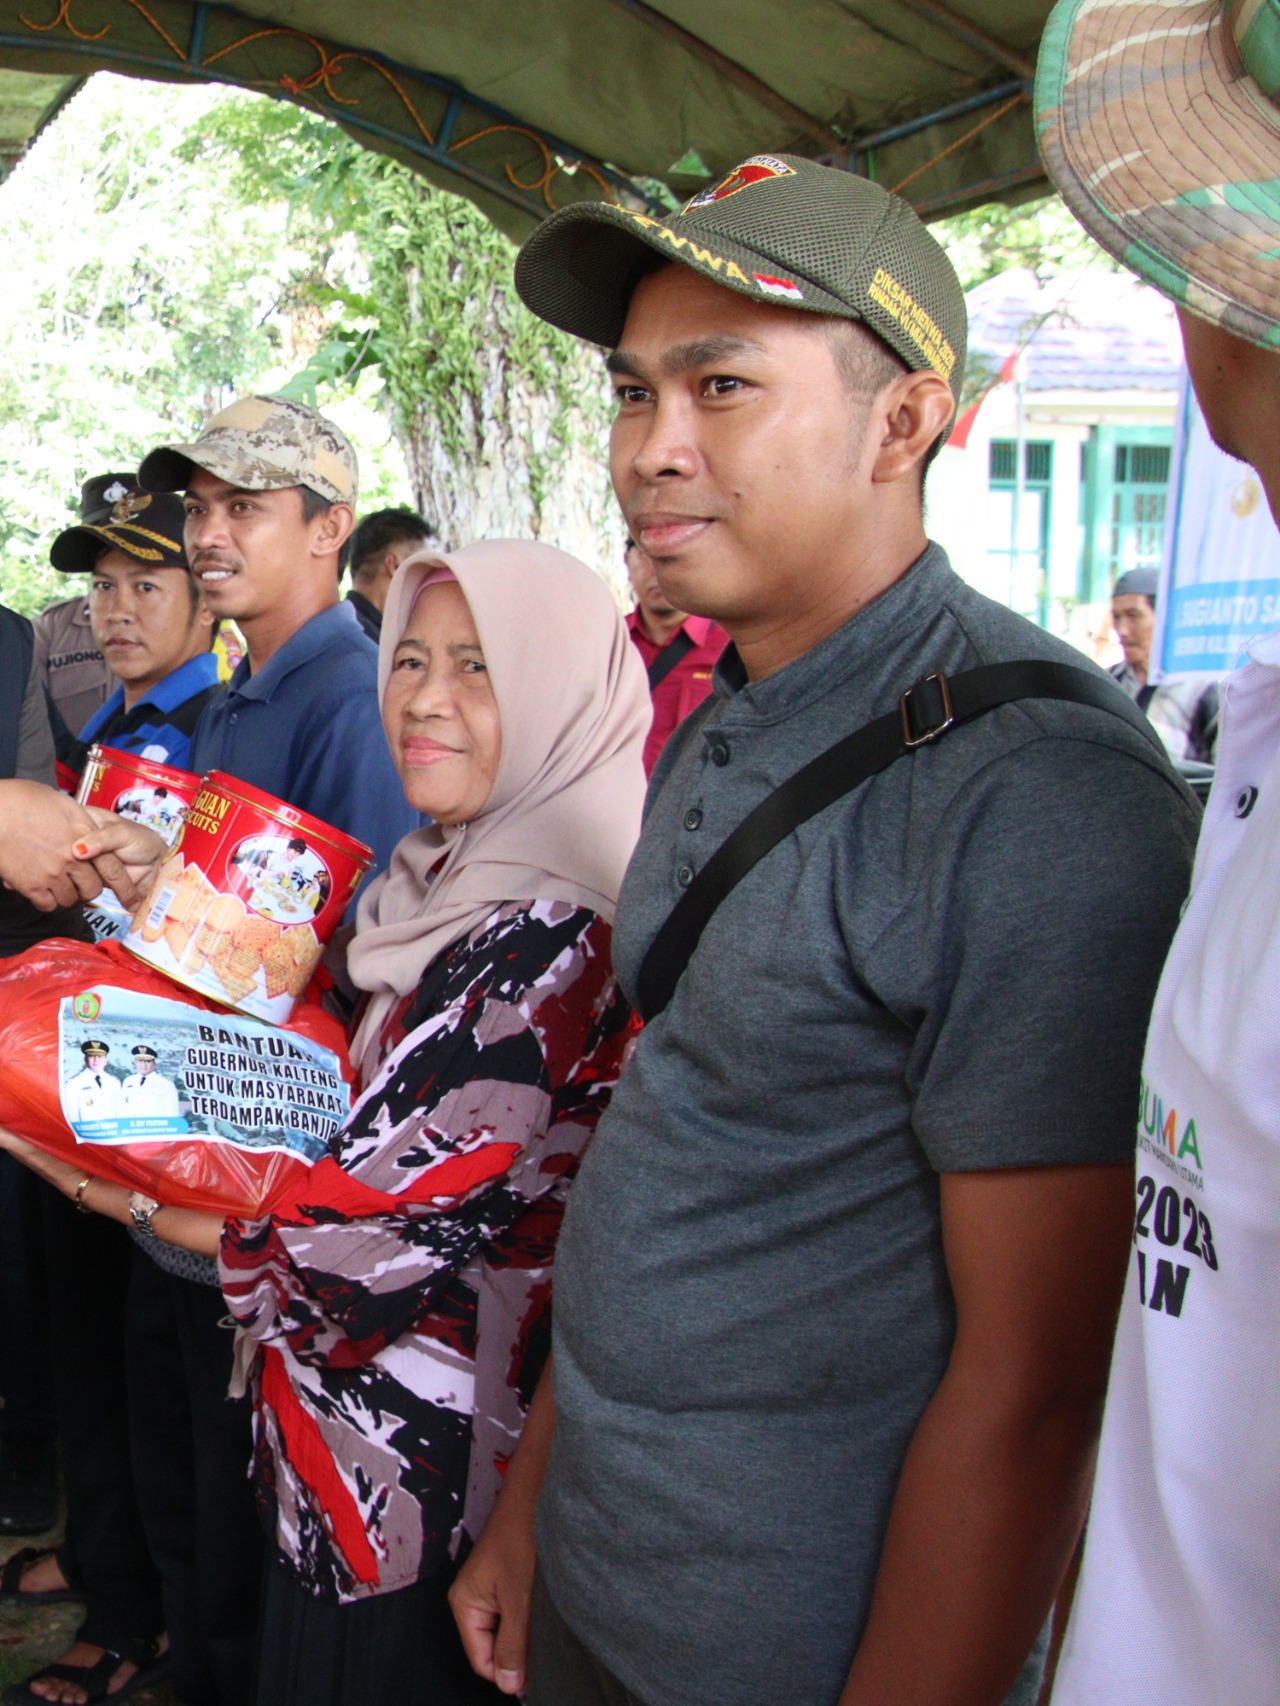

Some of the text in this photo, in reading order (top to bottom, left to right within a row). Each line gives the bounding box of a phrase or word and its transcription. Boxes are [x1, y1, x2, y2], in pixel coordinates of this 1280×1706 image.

[873, 267, 913, 313] DIKSAR
[187, 1048, 338, 1090] GUBERNUR KALTENG
[185, 1071, 344, 1116] UNTUK MASYARAKAT
[191, 1096, 338, 1142] TERDAMPAK BANJIR
[1135, 1175, 1219, 1272] 2023
